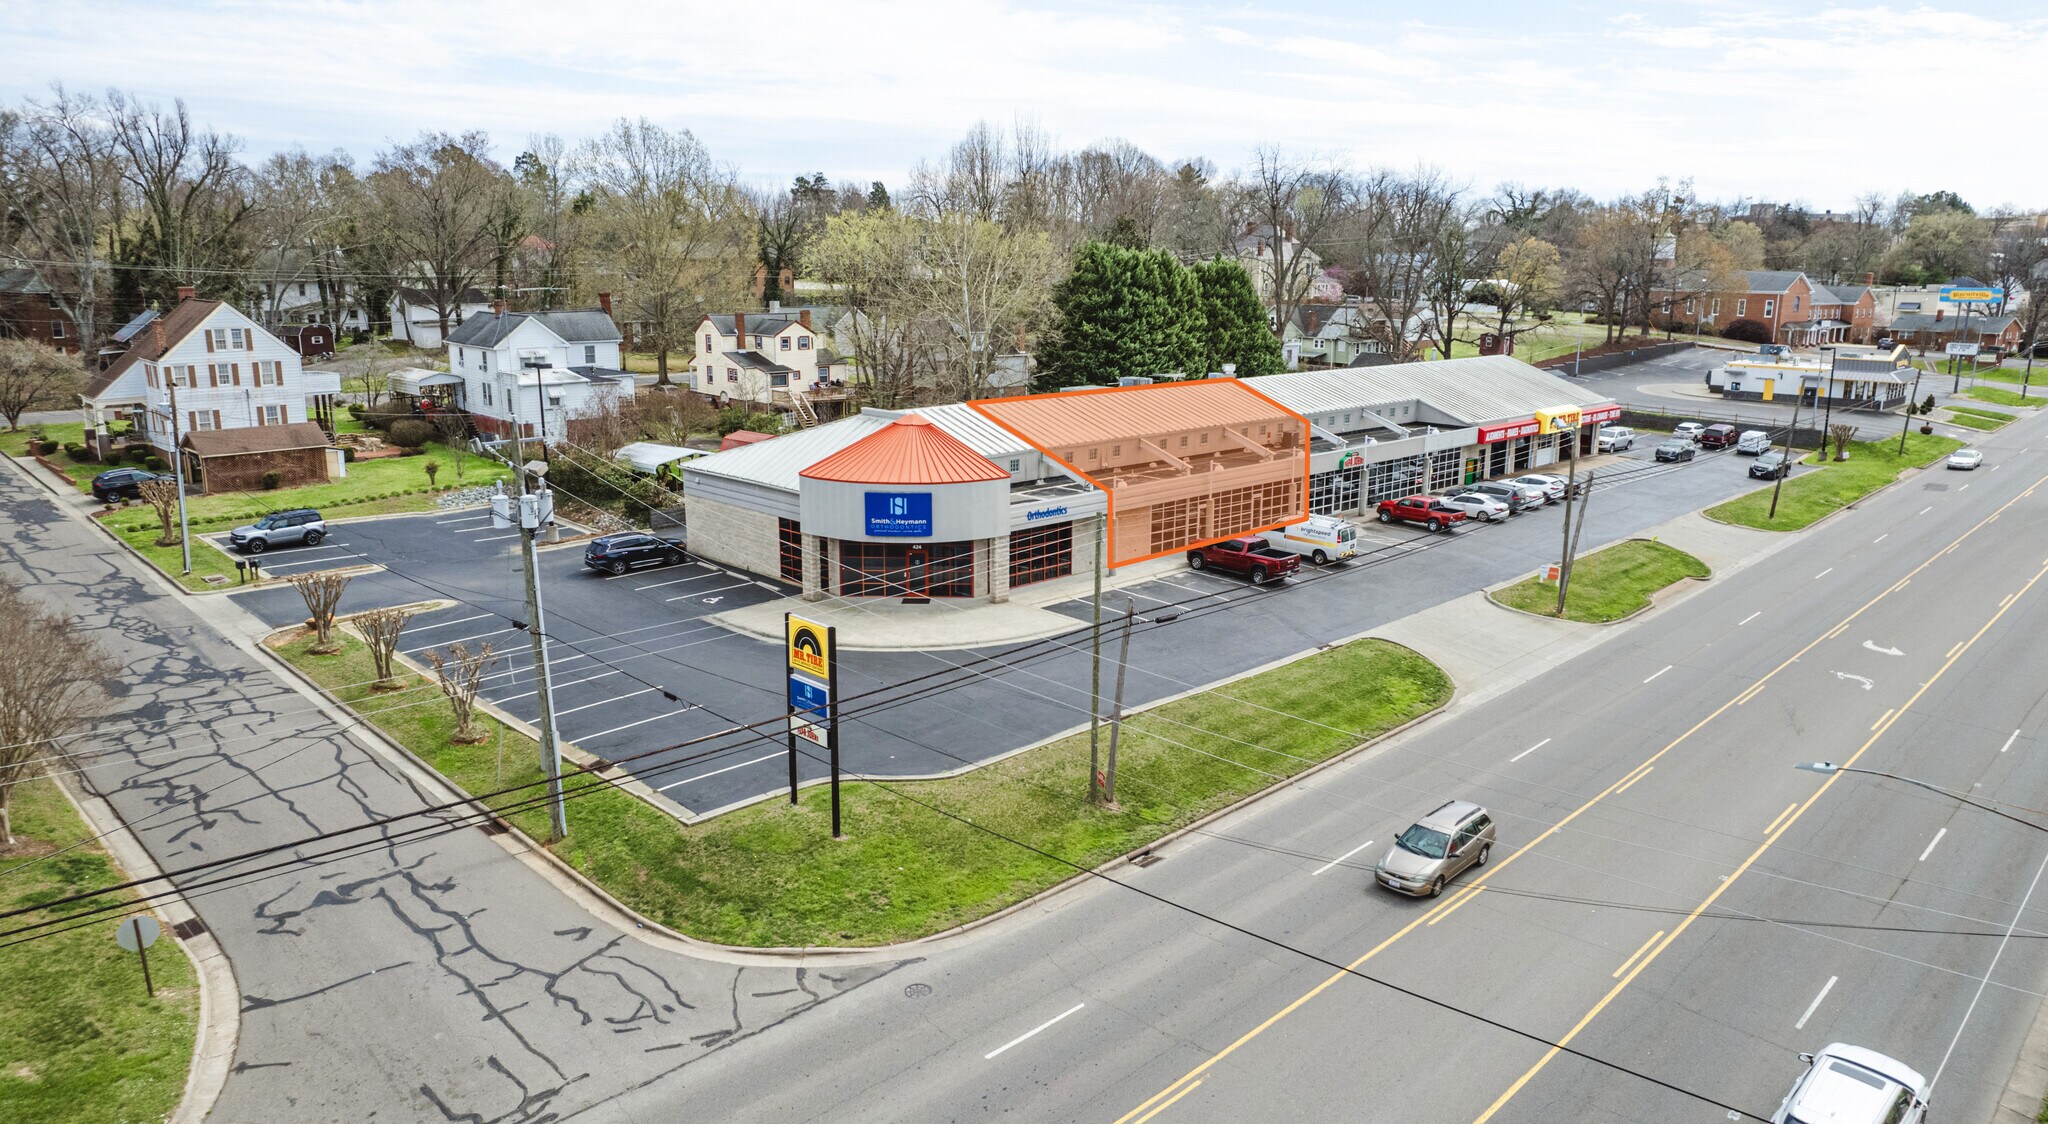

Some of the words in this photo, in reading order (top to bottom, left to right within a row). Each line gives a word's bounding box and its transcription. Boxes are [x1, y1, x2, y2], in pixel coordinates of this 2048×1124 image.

[1027, 506, 1068, 521] Orthodontics
[1300, 527, 1331, 536] brightspeed
[793, 648, 806, 661] MR.
[805, 653, 823, 668] TIRE
